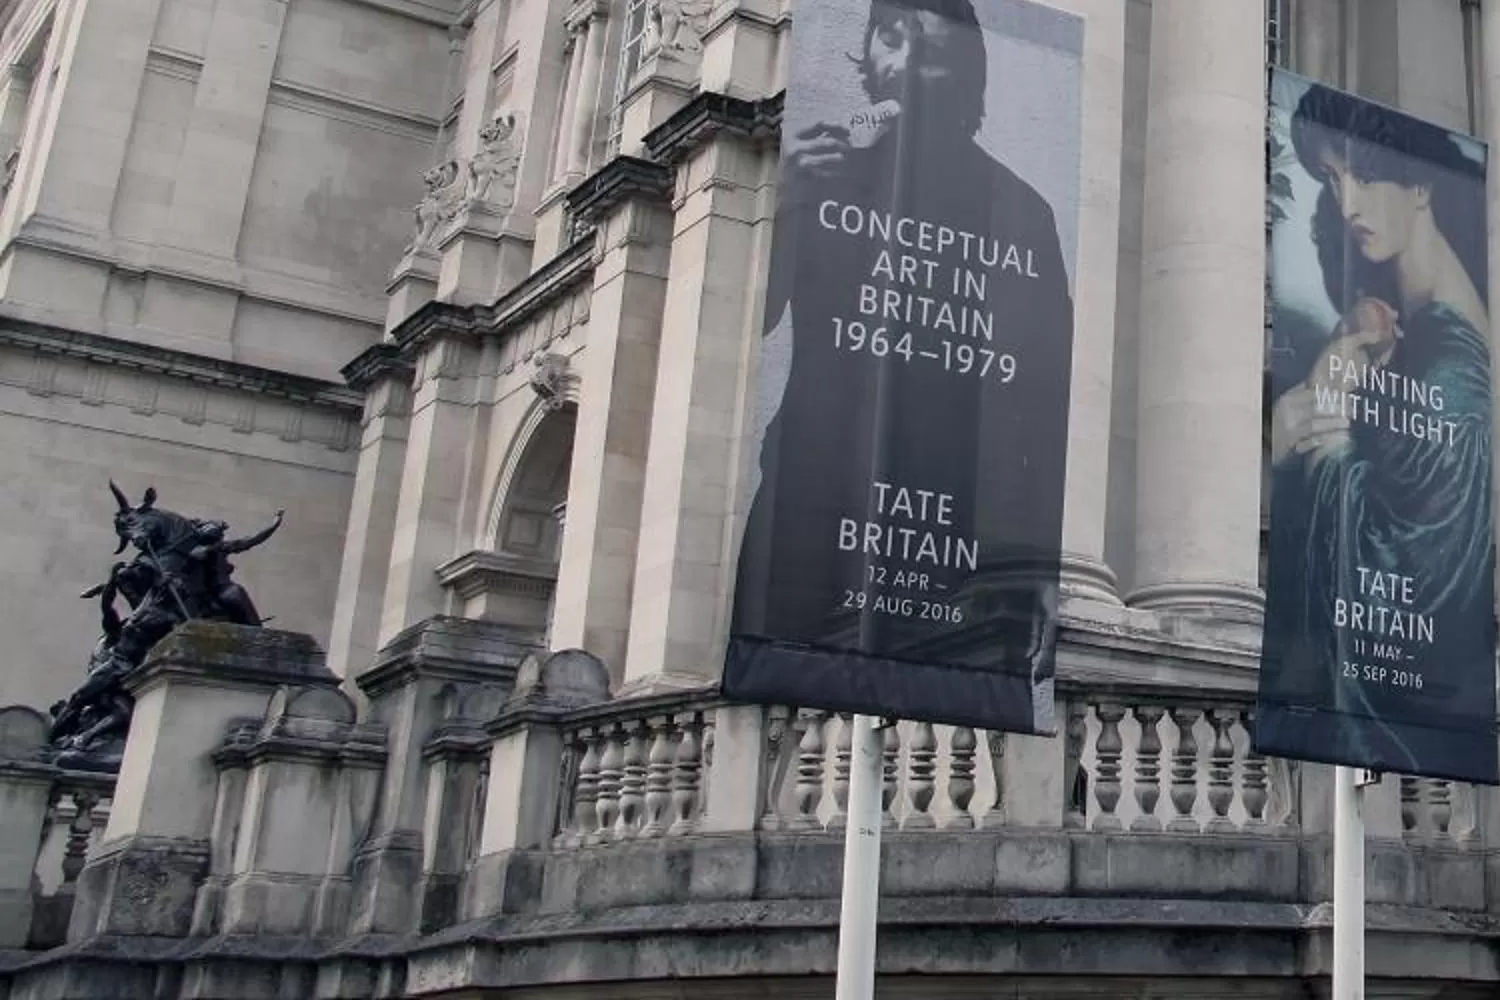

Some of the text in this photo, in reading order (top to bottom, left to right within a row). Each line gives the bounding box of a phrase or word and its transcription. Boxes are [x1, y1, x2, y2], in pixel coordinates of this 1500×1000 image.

[819, 200, 1039, 278] CONCEPTUAL
[872, 250, 986, 301] ART IN
[859, 284, 993, 341] BRITAIN
[1329, 354, 1444, 411] PAINTING
[1315, 384, 1457, 447] WITH LIGHT
[873, 481, 953, 525] TATE
[838, 517, 979, 571] BRITAIN
[867, 565, 887, 584] 12
[893, 569, 929, 591] APR
[1356, 567, 1413, 604] TATE
[843, 589, 963, 623] 29 AUG 2016
[1334, 597, 1433, 643] BRITAIN
[1355, 639, 1365, 656] 11
[1373, 642, 1402, 661] MAY
[1342, 661, 1423, 689] 25 SEP 2016
